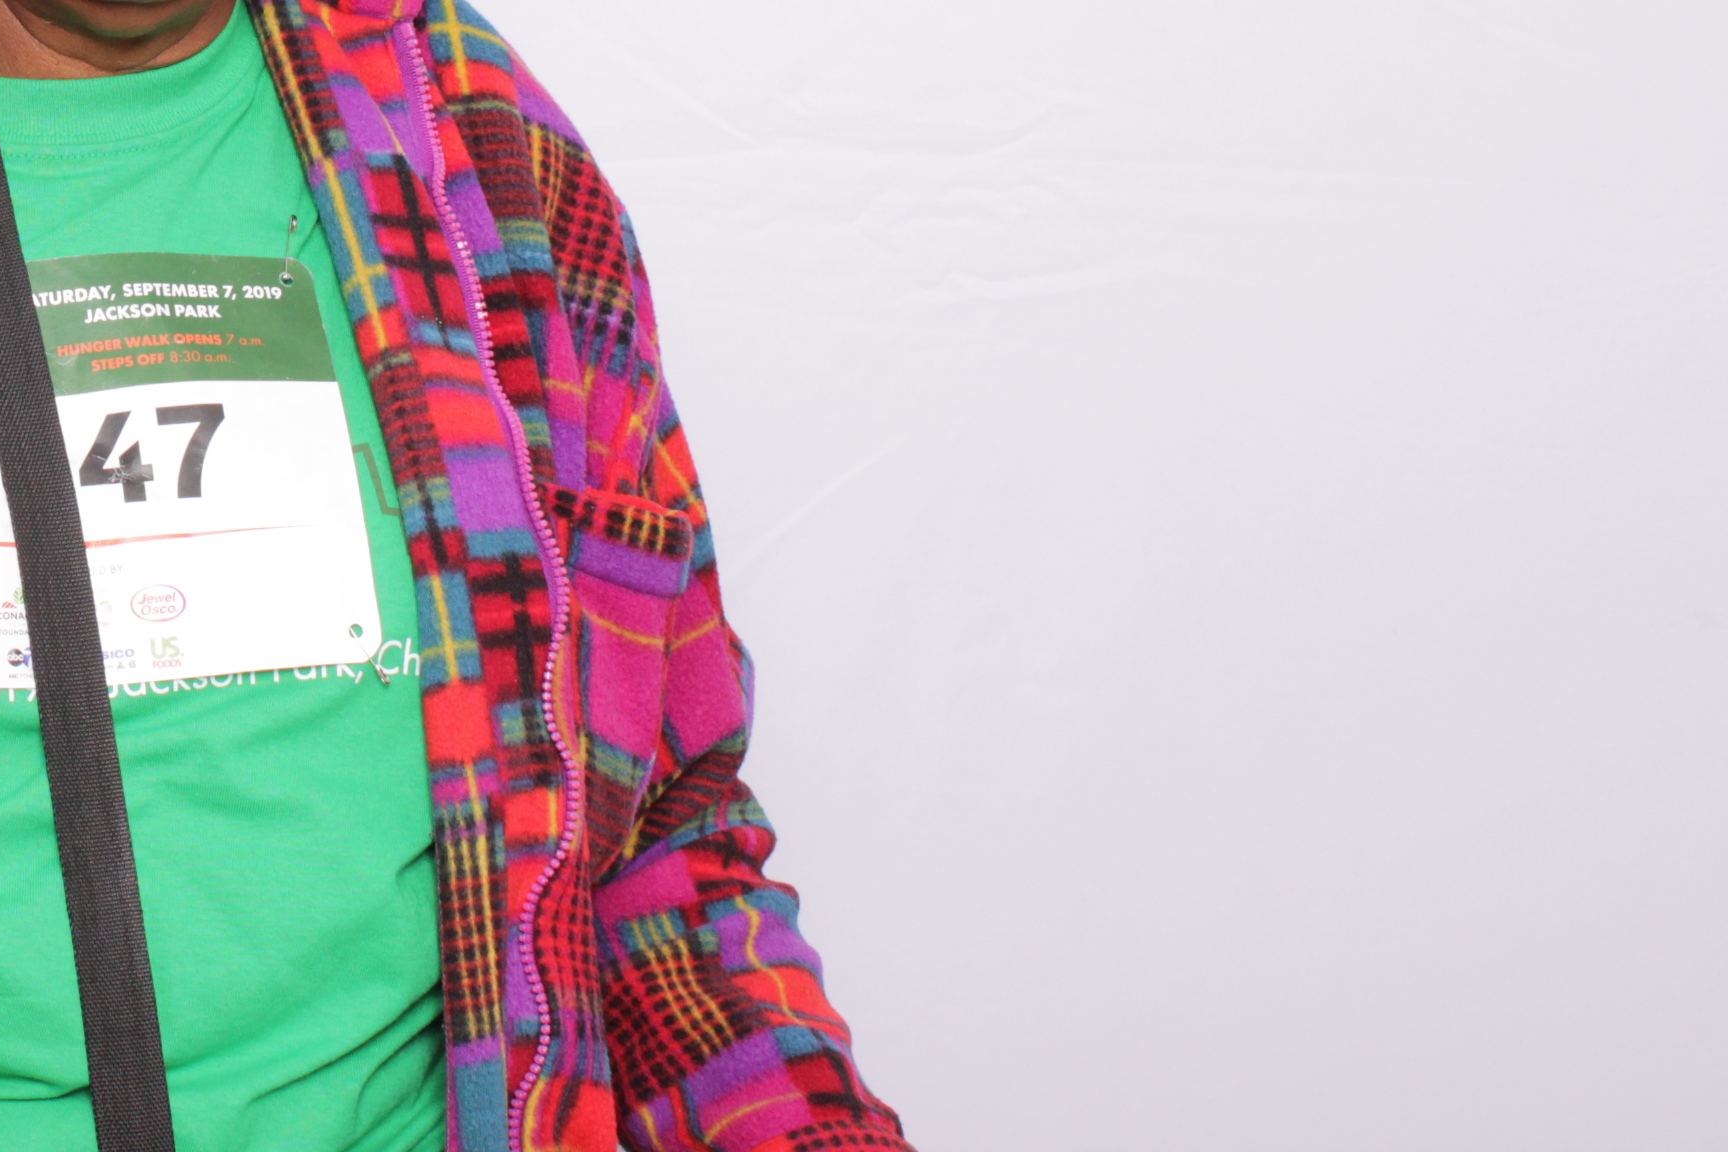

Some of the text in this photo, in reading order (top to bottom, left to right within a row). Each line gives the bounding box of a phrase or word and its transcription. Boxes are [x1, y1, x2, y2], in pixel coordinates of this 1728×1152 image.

[122, 282, 219, 298] SEPTEMBER
[222, 285, 237, 301] 7,
[242, 285, 282, 300] 2019
[84, 303, 222, 324] JACKSON PARK
[56, 333, 266, 357] HUNGER WALK OPENS 7 a.m.
[91, 350, 232, 372] STEPS OFF 8:30 a.m.
[92, 566, 107, 576] ED
[138, 591, 176, 605] Jewel
[101, 648, 135, 660] SICO
[377, 637, 421, 677] Ch
[152, 659, 182, 669] FOODS
